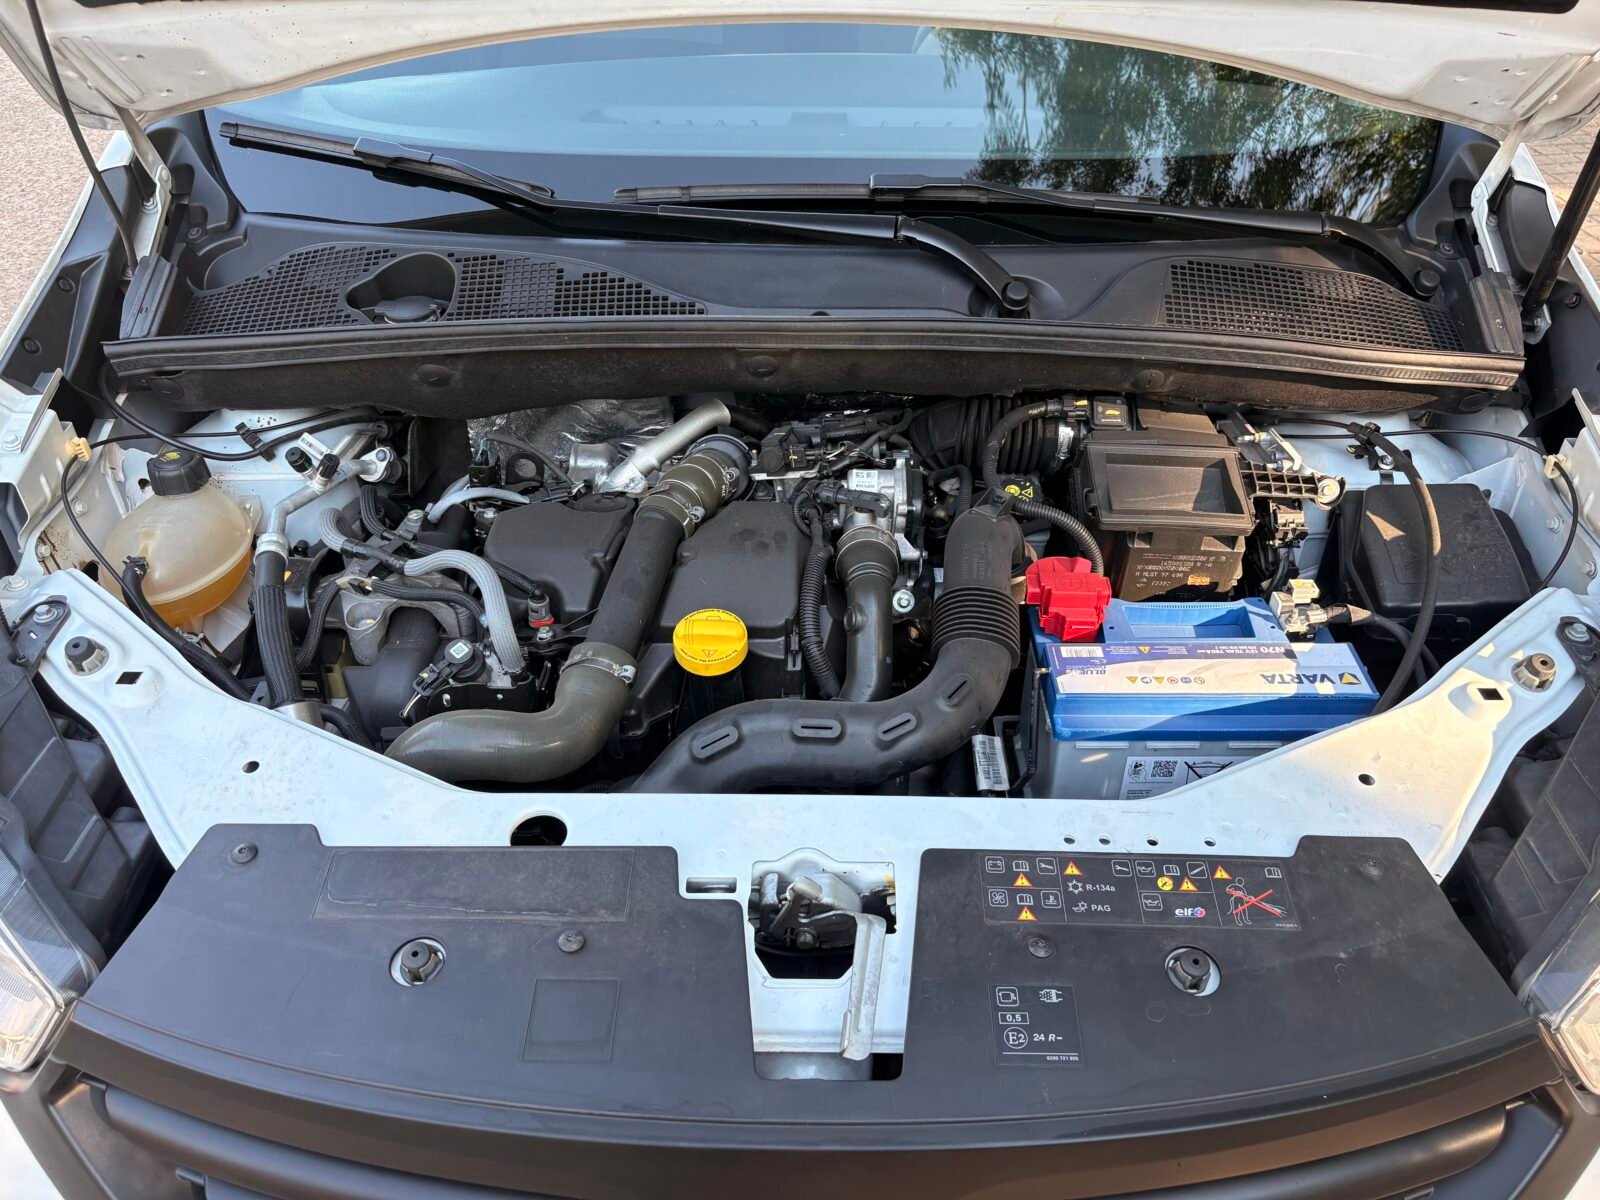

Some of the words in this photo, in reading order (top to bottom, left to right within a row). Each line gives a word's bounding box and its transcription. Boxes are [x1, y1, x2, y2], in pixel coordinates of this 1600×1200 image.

[1260, 673, 1336, 685] VARTA
[1086, 884, 1116, 892] R-134a
[1091, 904, 1111, 912] PAG
[1174, 907, 1195, 916] elf
[1006, 1014, 1022, 1023] 0,5
[1008, 1031, 1026, 1045] E2
[1032, 1033, 1046, 1042] 24
